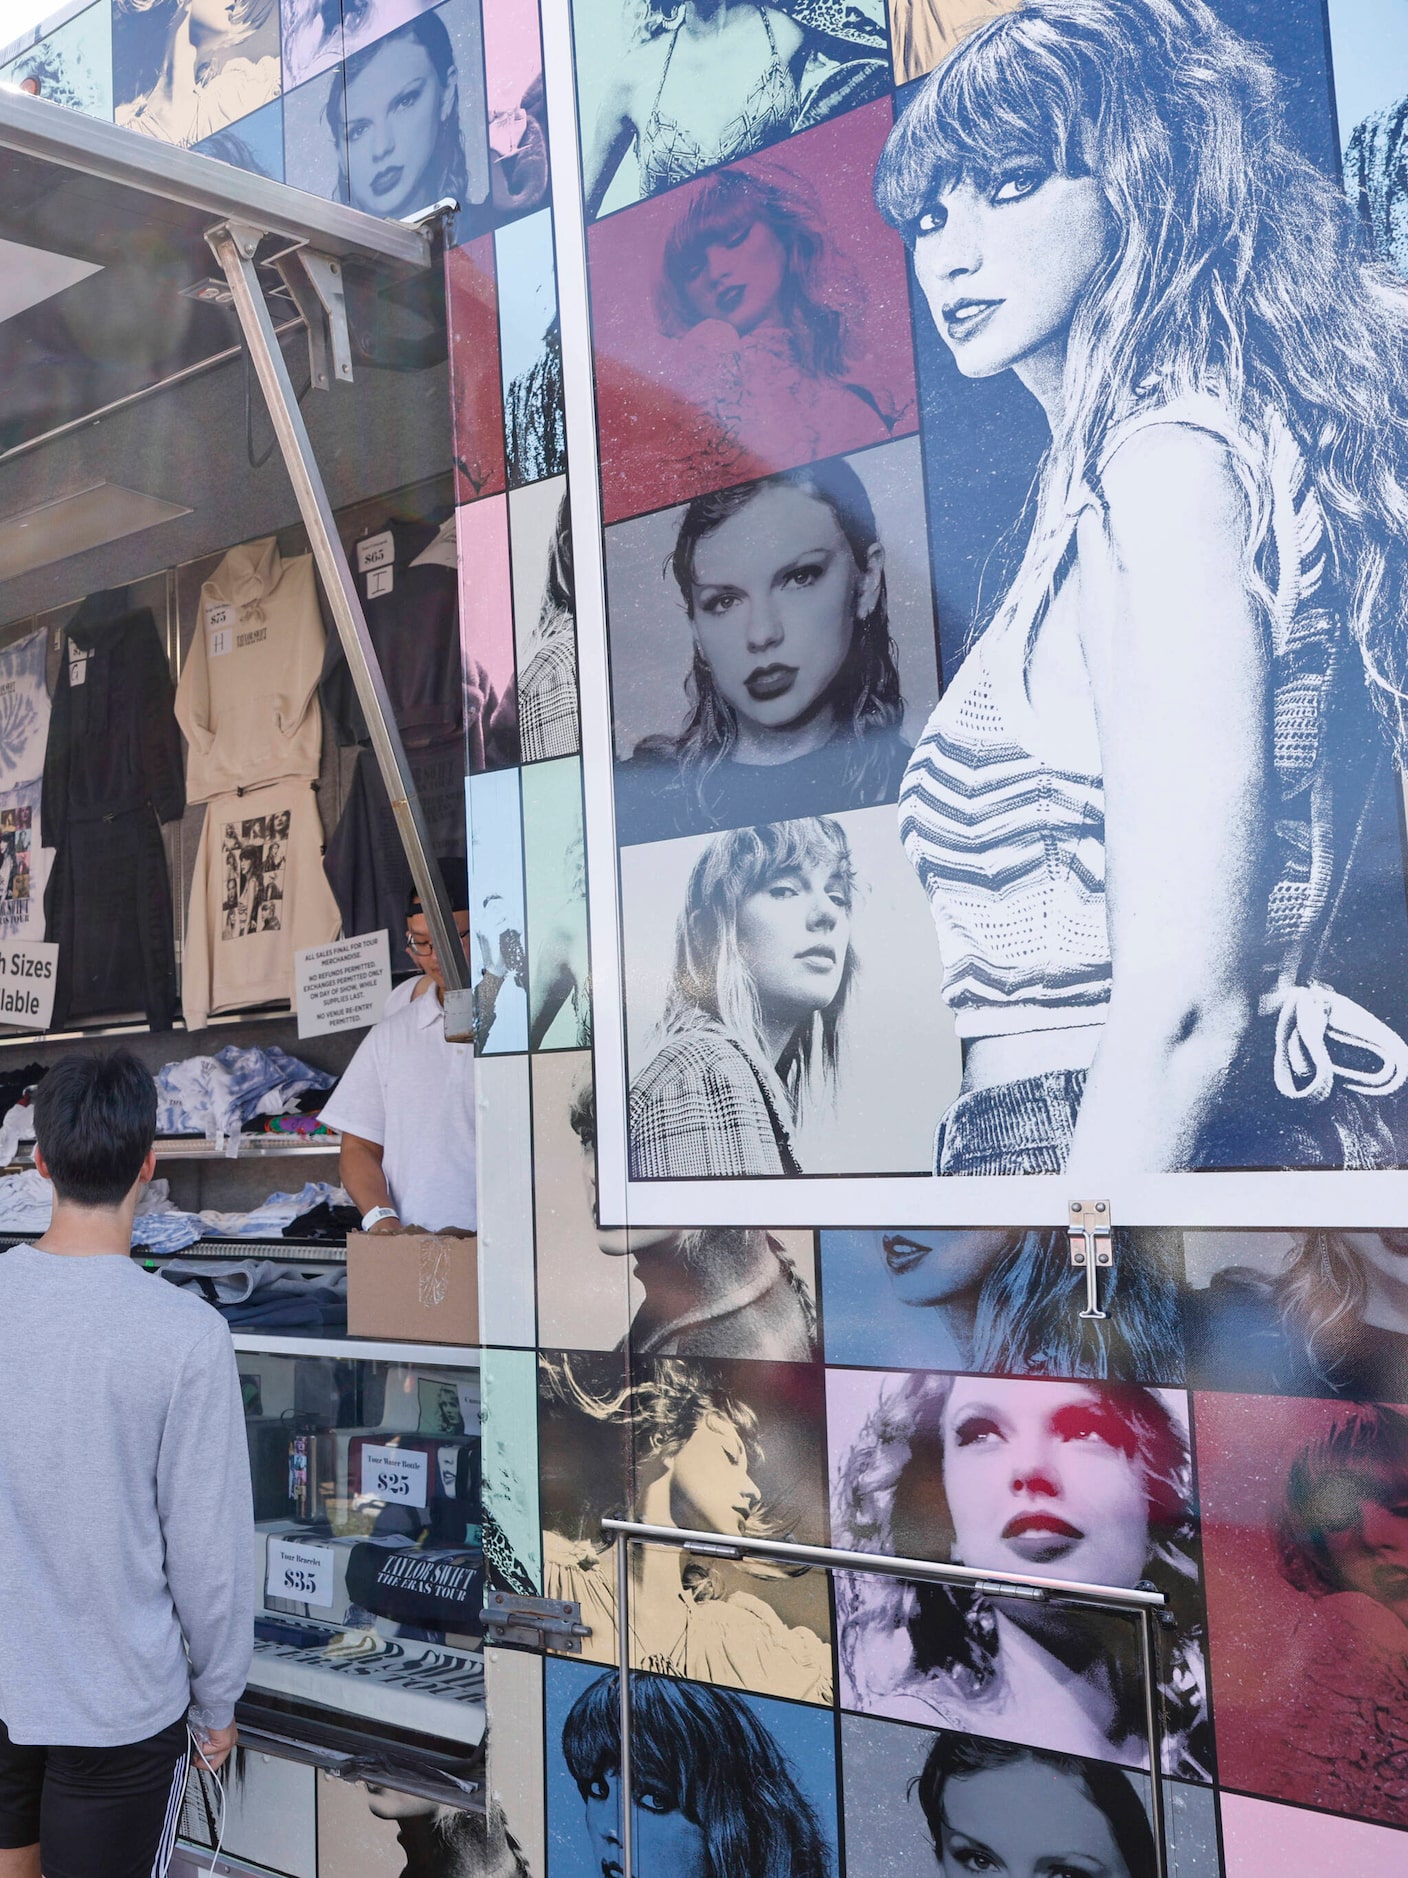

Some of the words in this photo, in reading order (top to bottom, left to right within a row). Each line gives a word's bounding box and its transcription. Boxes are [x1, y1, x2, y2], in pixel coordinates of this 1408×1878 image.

[365, 549, 384, 564] $65
[210, 611, 226, 625] $75
[214, 633, 224, 652] H
[316, 950, 332, 959] SALES
[351, 943, 362, 951] FOR
[363, 939, 378, 947] TOUR
[10, 954, 52, 979] Sizes
[318, 970, 343, 980] REFUNDS
[304, 981, 336, 992] EXCHANGES
[337, 973, 367, 984] PERMITTED
[368, 969, 383, 978] ONLY
[359, 979, 377, 988] WHILE
[324, 994, 349, 1006] SUPPLIES
[327, 1009, 344, 1018] VENUE
[345, 1003, 373, 1013] RE-ENTRY
[368, 1455, 382, 1464] Tour
[402, 1461, 420, 1469] Bottle
[377, 1472, 409, 1495] $25
[280, 1552, 295, 1560] Tour
[296, 1554, 320, 1566] Bracelet
[284, 1568, 316, 1593] $35
[382, 1555, 434, 1581] TAYLOR
[430, 1563, 477, 1590] SWIFT
[377, 1572, 402, 1587] THE
[401, 1578, 432, 1594] ERAS
[435, 1585, 467, 1602] TOUR
